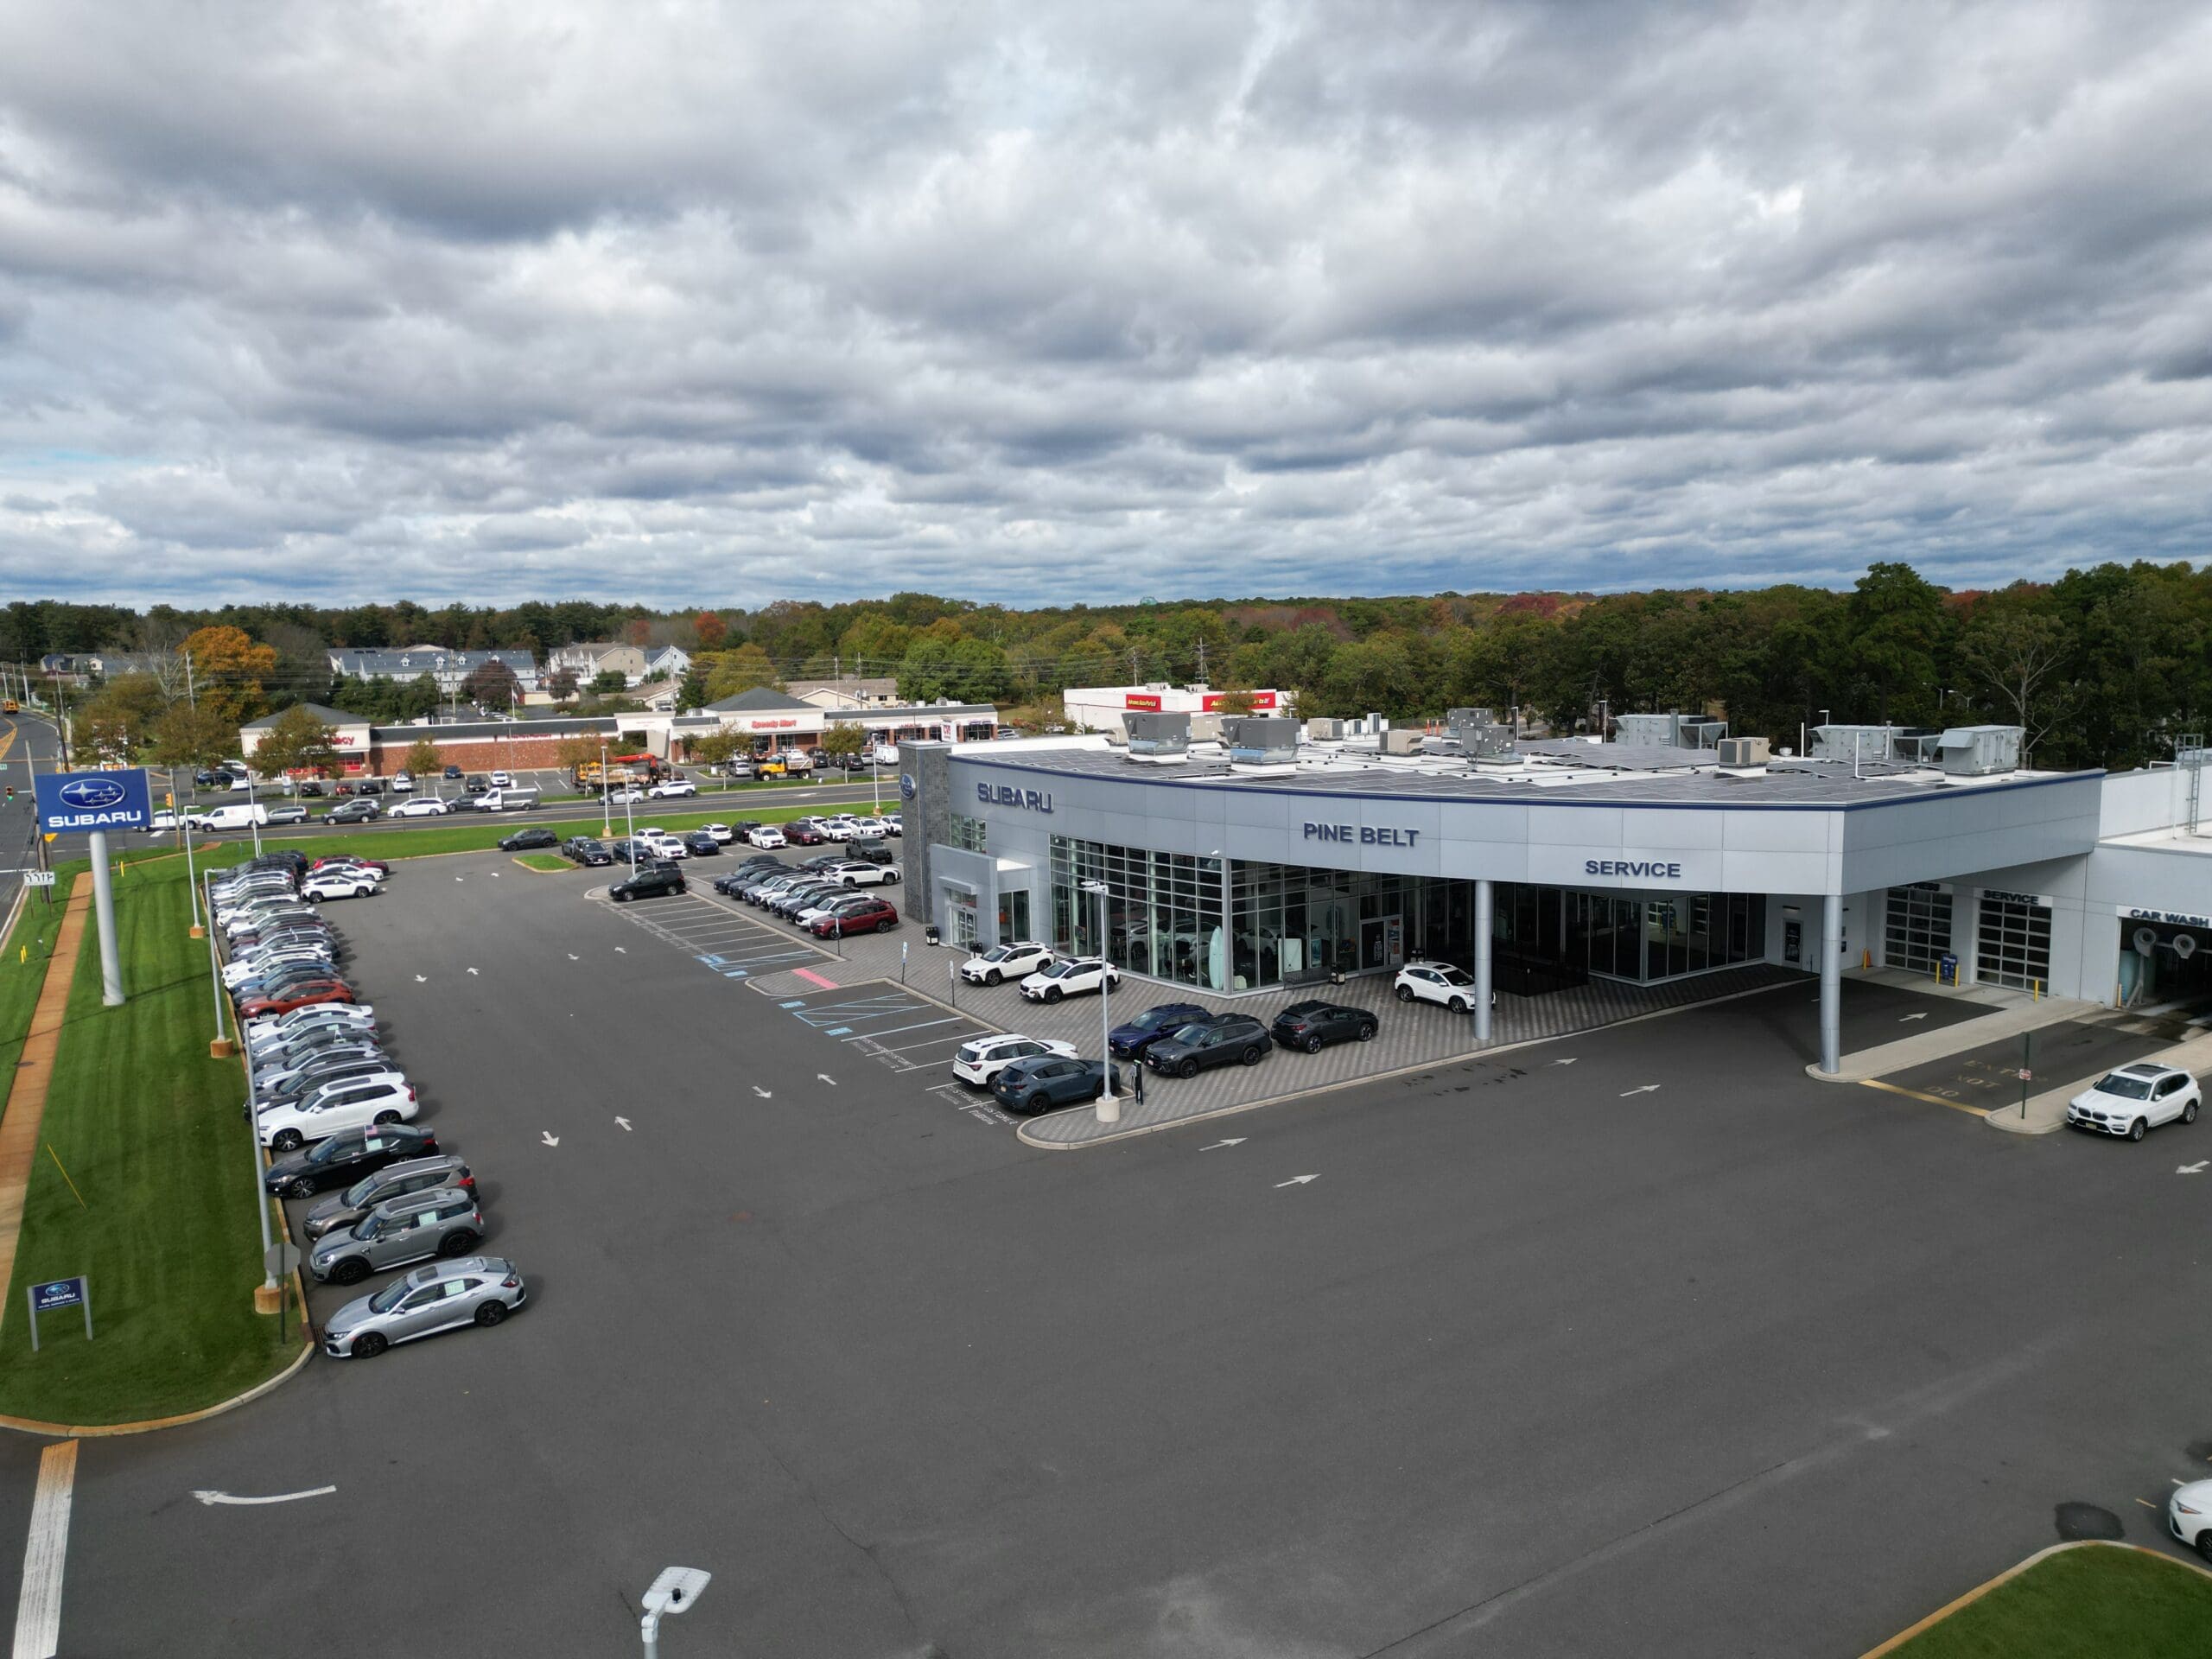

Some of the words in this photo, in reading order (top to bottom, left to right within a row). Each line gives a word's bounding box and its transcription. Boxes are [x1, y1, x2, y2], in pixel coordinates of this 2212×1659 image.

[977, 782, 1054, 814] SUBARU
[48, 810, 141, 828] SUBARU
[1304, 823, 1353, 842] PINE
[1360, 827, 1420, 847] BELT
[1586, 860, 1681, 877] SERVICE
[1984, 889, 2039, 905] SERVICE
[2130, 909, 2161, 921] CAR
[2165, 912, 2209, 927] WASH
[41, 1293, 75, 1304] SUBARU
